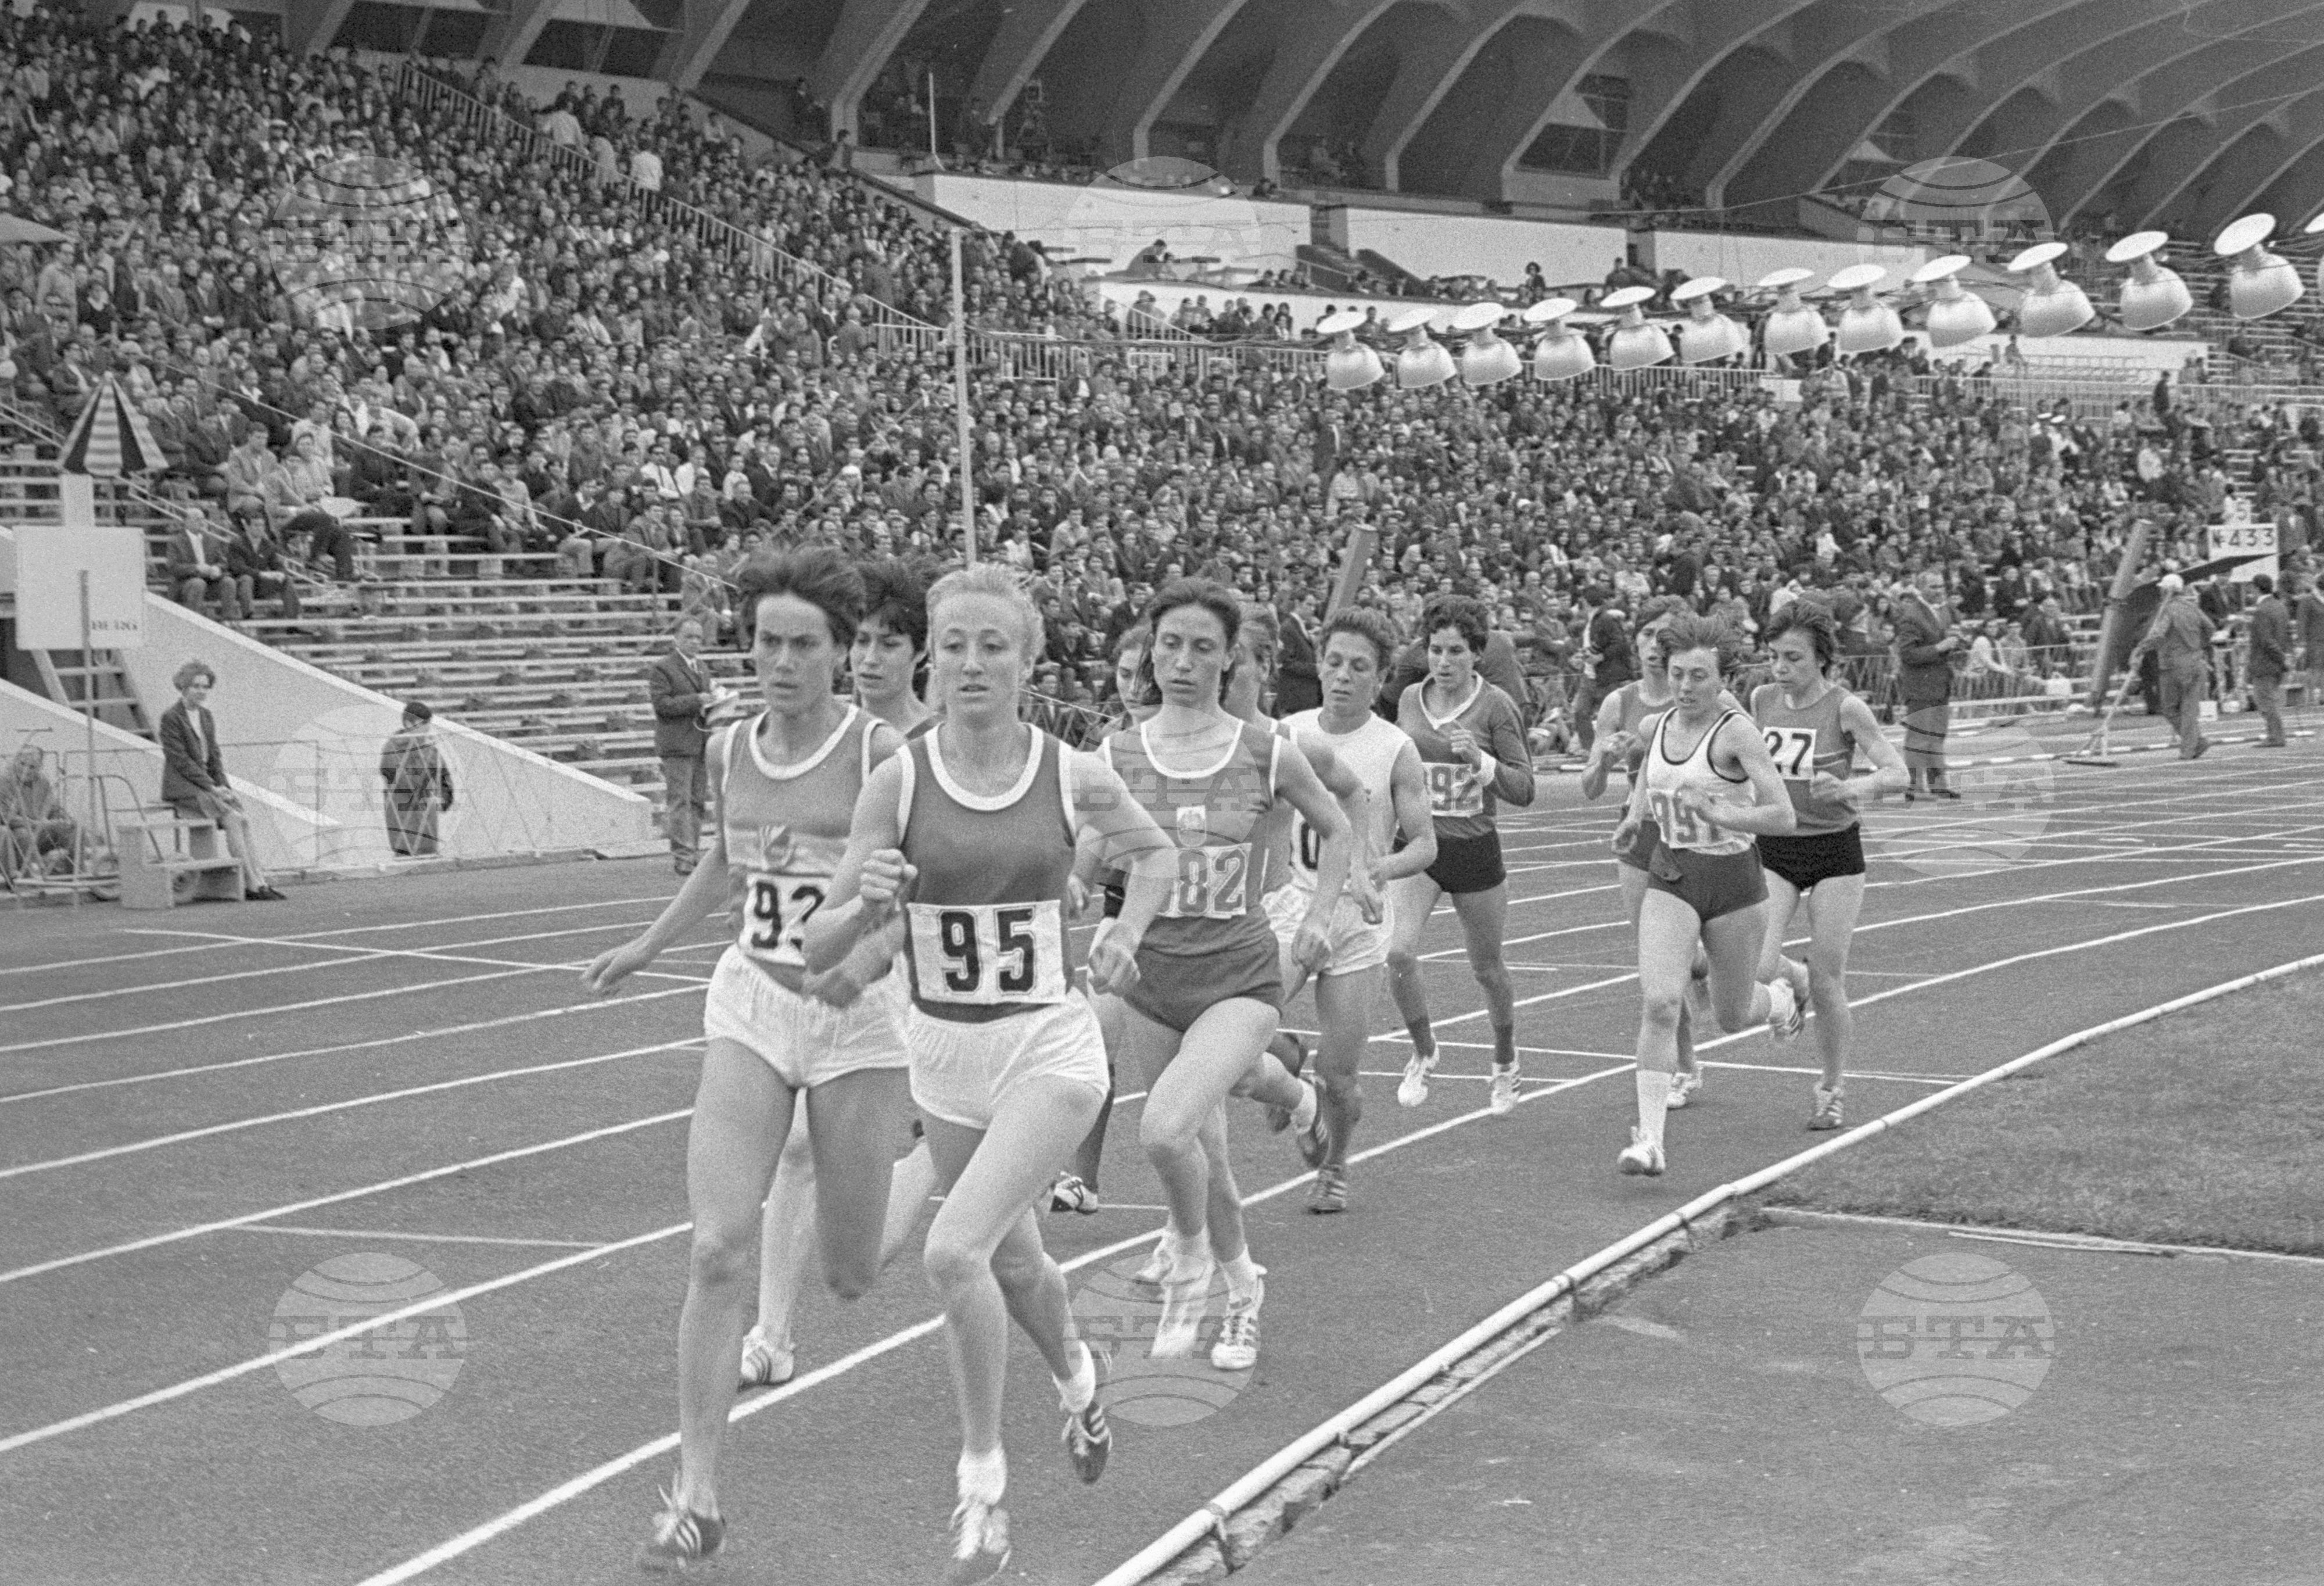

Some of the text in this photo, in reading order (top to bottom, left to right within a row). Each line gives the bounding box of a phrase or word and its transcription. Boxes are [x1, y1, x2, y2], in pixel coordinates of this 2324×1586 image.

[1764, 731, 1812, 775] 27
[1423, 765, 1479, 811] 92
[1162, 849, 1247, 913] 82
[751, 880, 826, 951] 92
[939, 907, 1037, 994] 95
